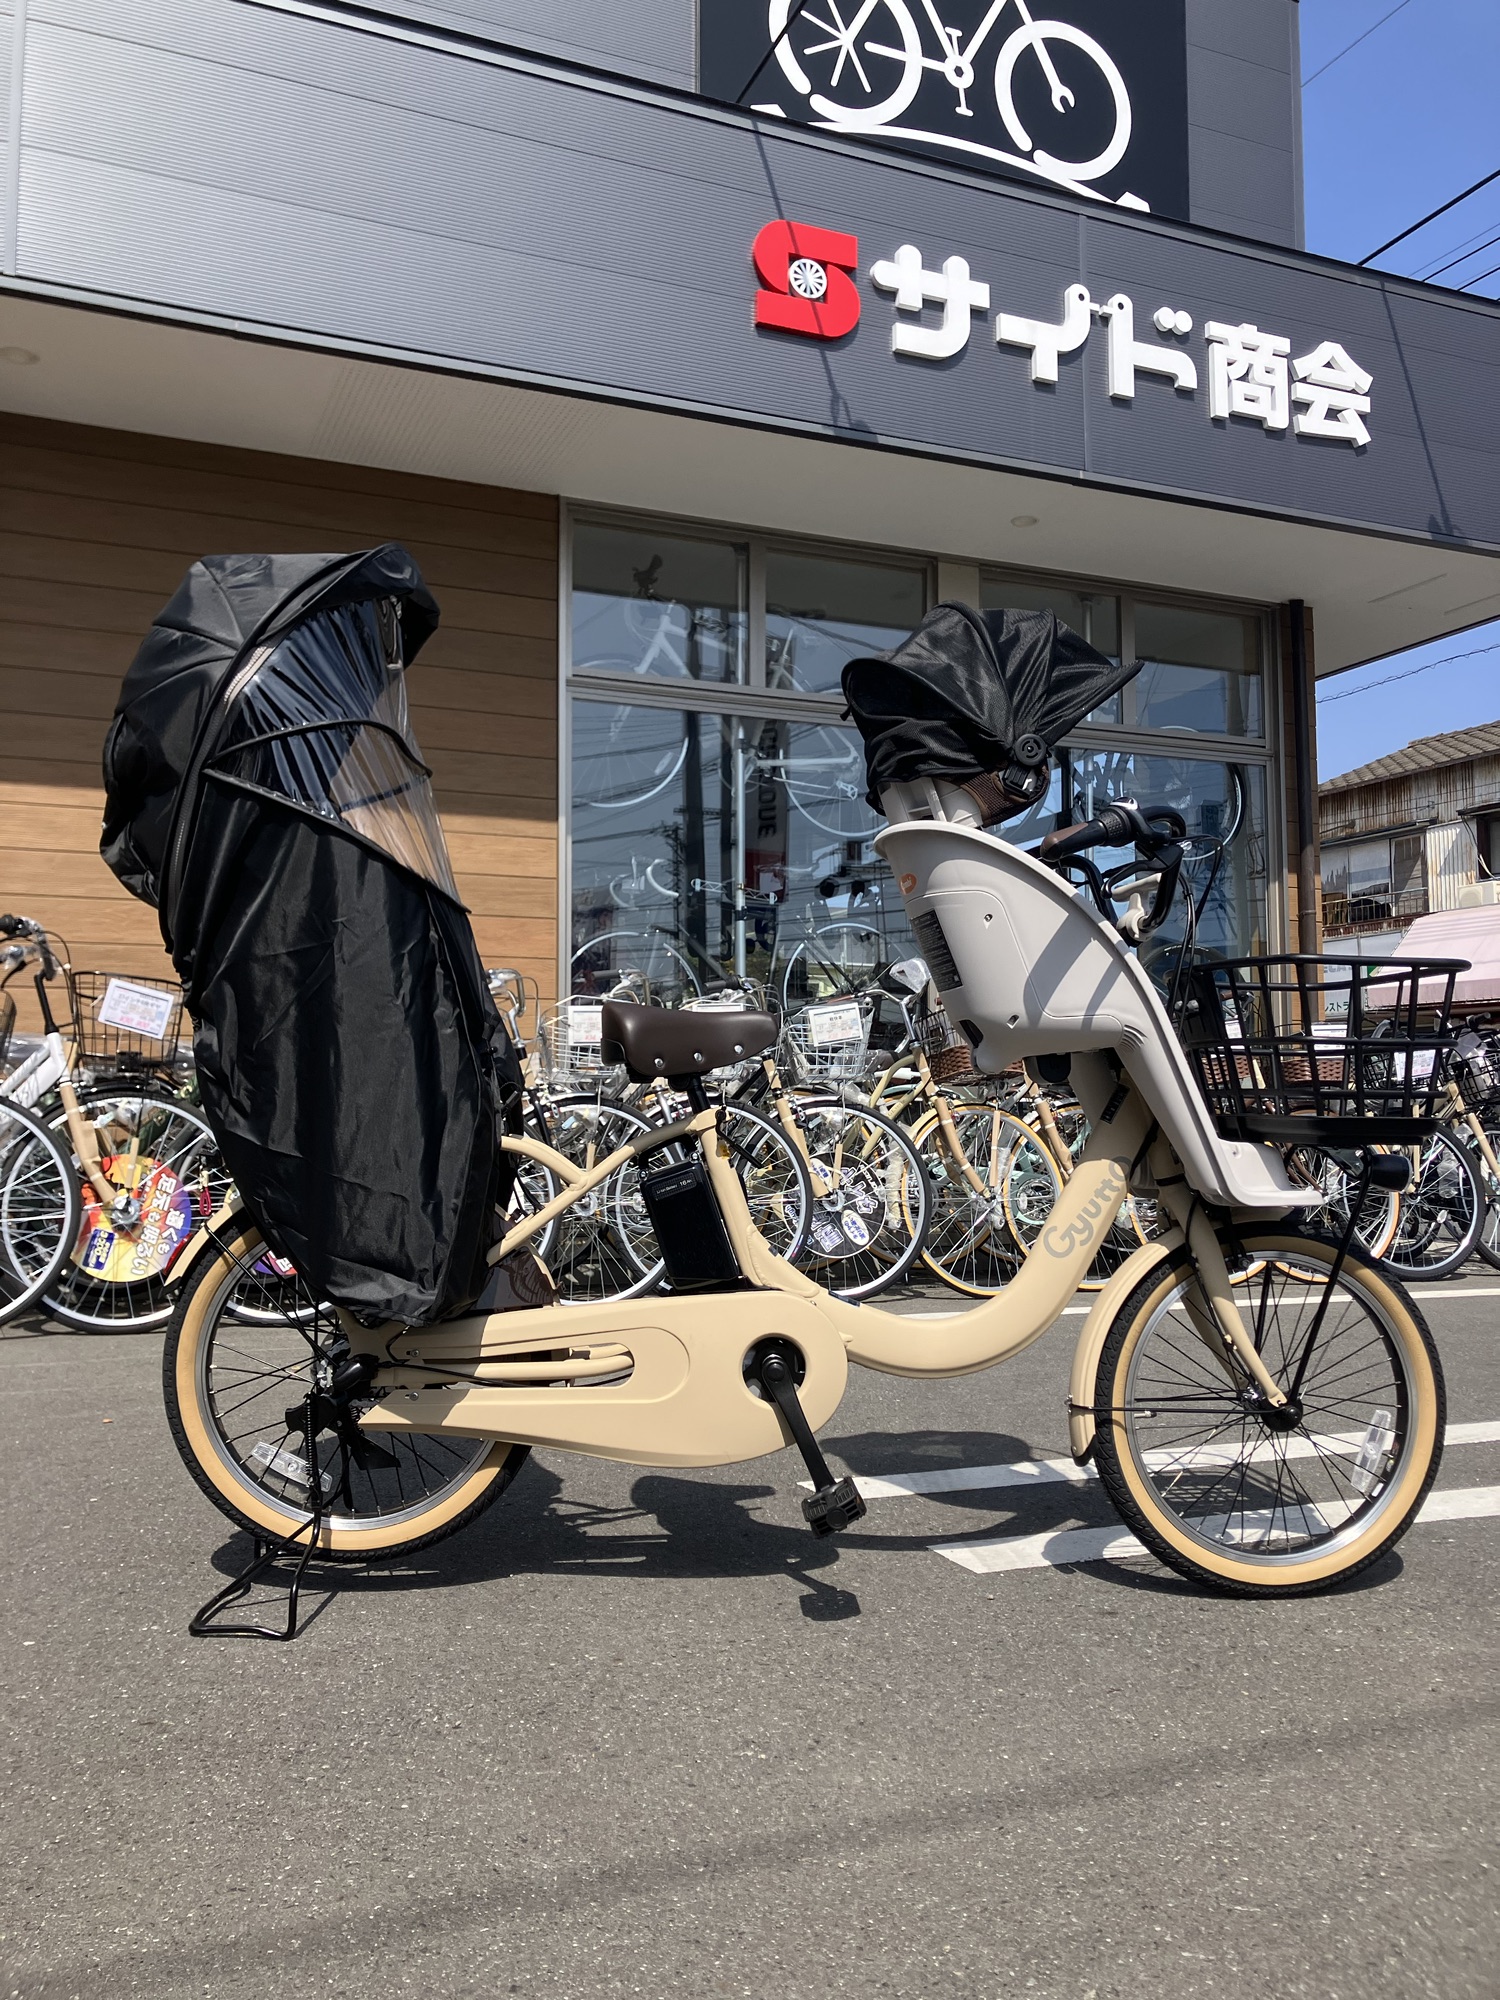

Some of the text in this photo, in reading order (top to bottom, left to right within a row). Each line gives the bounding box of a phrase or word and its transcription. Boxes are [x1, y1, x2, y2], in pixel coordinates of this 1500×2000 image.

[870, 244, 1373, 449] サイド商会
[130, 1173, 178, 1276] 足元も明るい
[1043, 1156, 1132, 1259] Gyutto
